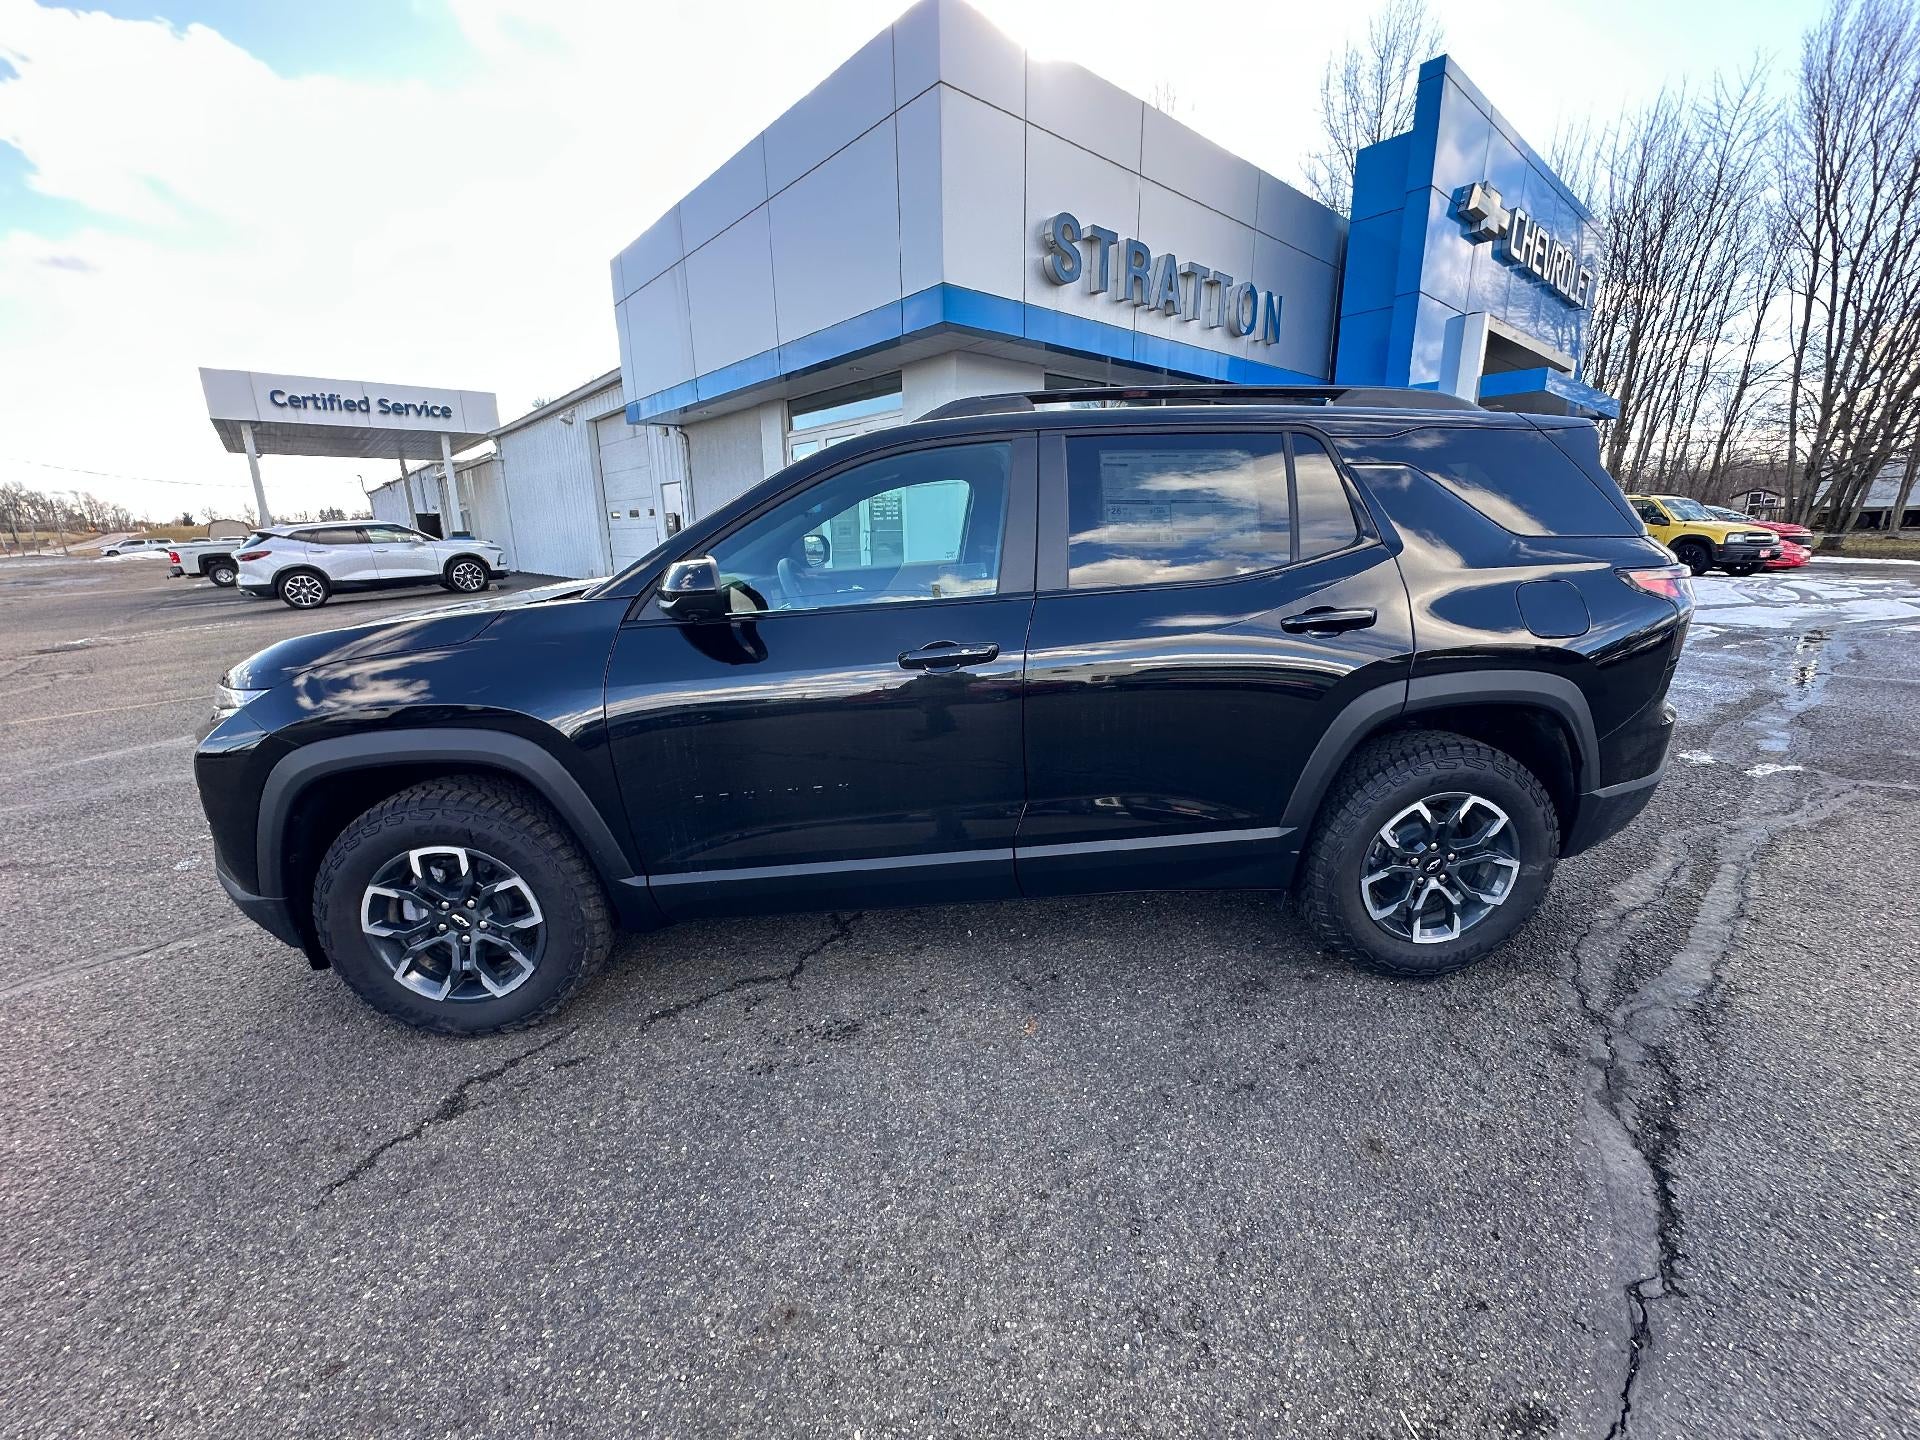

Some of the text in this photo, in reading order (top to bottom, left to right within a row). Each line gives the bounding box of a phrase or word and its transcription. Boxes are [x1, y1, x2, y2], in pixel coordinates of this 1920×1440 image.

[1043, 212, 1283, 345] STRATTON
[1509, 207, 1594, 310] CHEVROLET
[270, 389, 453, 418] Certified Service
